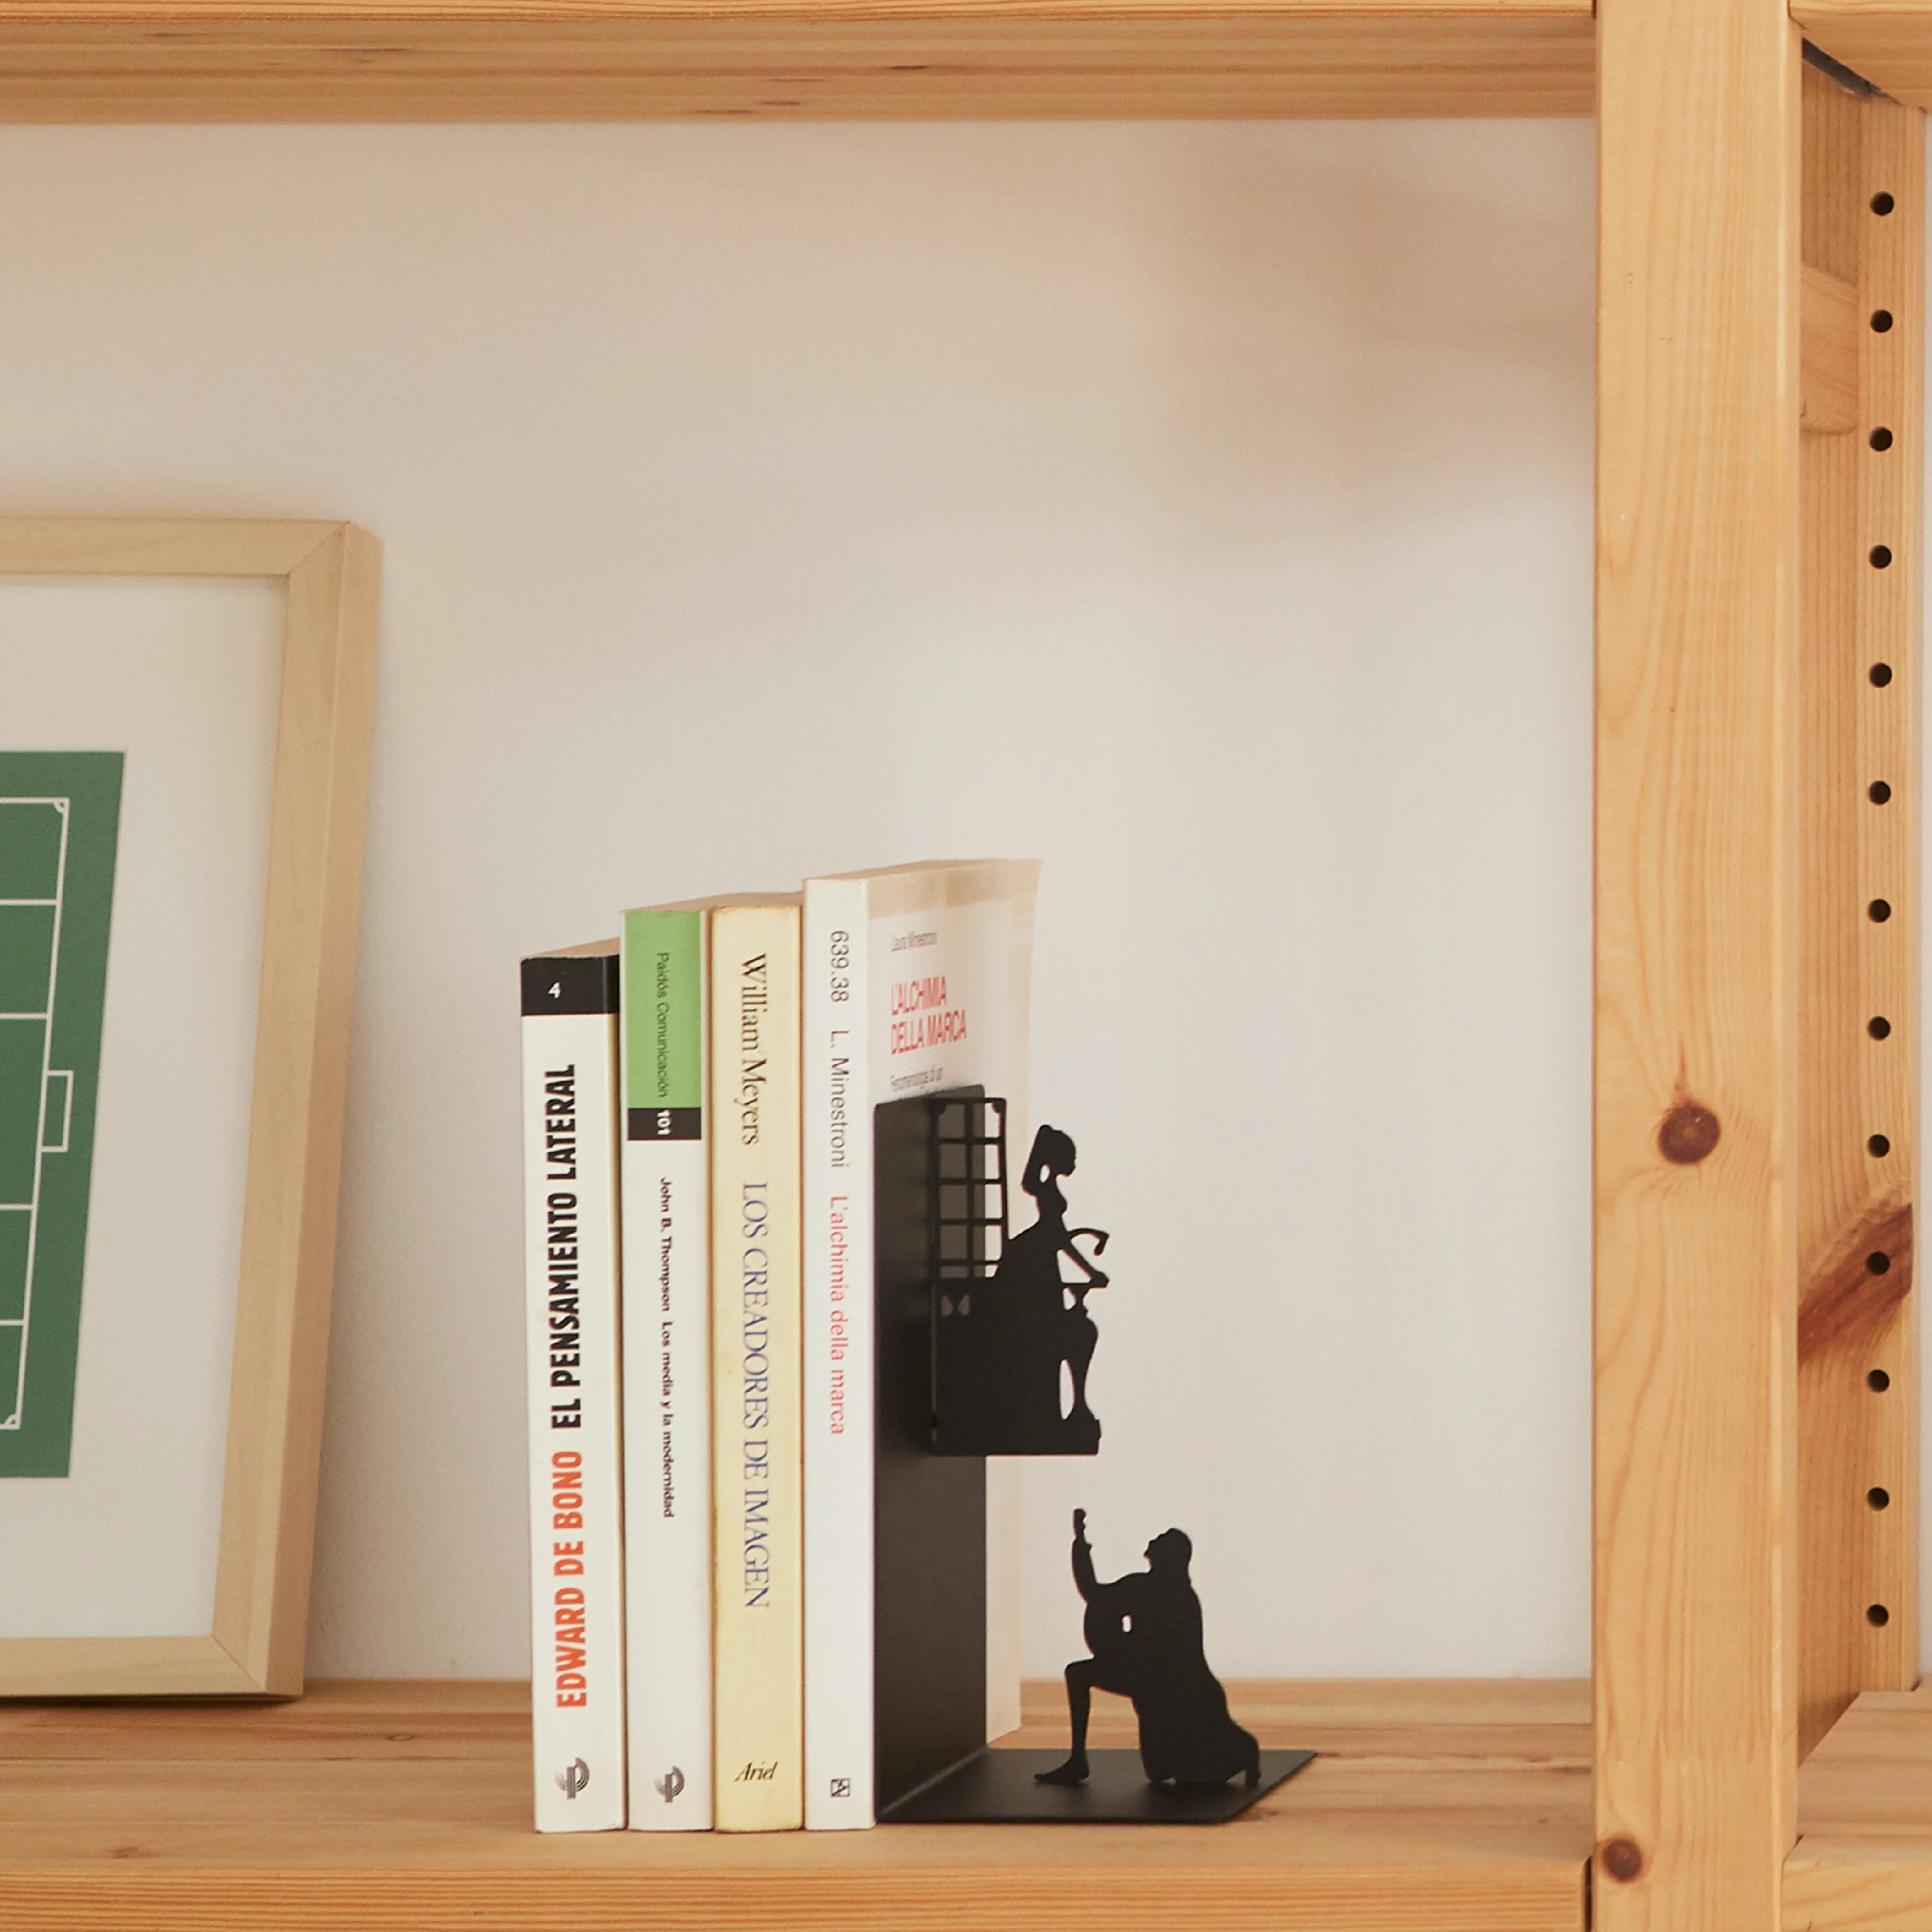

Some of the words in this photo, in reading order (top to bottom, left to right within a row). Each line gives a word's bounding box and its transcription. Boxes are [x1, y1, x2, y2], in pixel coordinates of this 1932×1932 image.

[548, 983, 561, 998] 4
[657, 952, 669, 998] Paidós
[831, 932, 849, 1002] 639.38
[742, 954, 767, 1051] William
[832, 1031, 849, 1047] L.
[544, 1064, 577, 1180] LATERAL
[657, 1109, 671, 1136] 101
[734, 1059, 767, 1145] Meyers
[831, 1058, 849, 1166] Minestroni
[661, 1178, 671, 1212] John
[744, 1183, 767, 1238] LOS
[661, 1218, 671, 1231] B.
[831, 1196, 849, 1301] L'alchimia
[547, 1192, 580, 1387] PENSAMIENTO
[659, 1236, 672, 1311] Thompson
[662, 1322, 672, 1347] Los
[744, 1248, 767, 1428] CREADORES
[831, 1310, 849, 1360] della
[663, 1353, 672, 1396] media
[551, 1399, 581, 1429] EL
[660, 1400, 671, 1409] y
[663, 1414, 674, 1426] la
[831, 1370, 844, 1434] marca
[663, 1431, 674, 1518] modernidad
[744, 1440, 767, 1479] DE
[552, 1451, 583, 1530] BONO
[554, 1541, 584, 1576] DE
[744, 1489, 769, 1608] IMAGEN
[555, 1588, 587, 1708] EDWARD
[735, 1762, 777, 1781] Ariel
